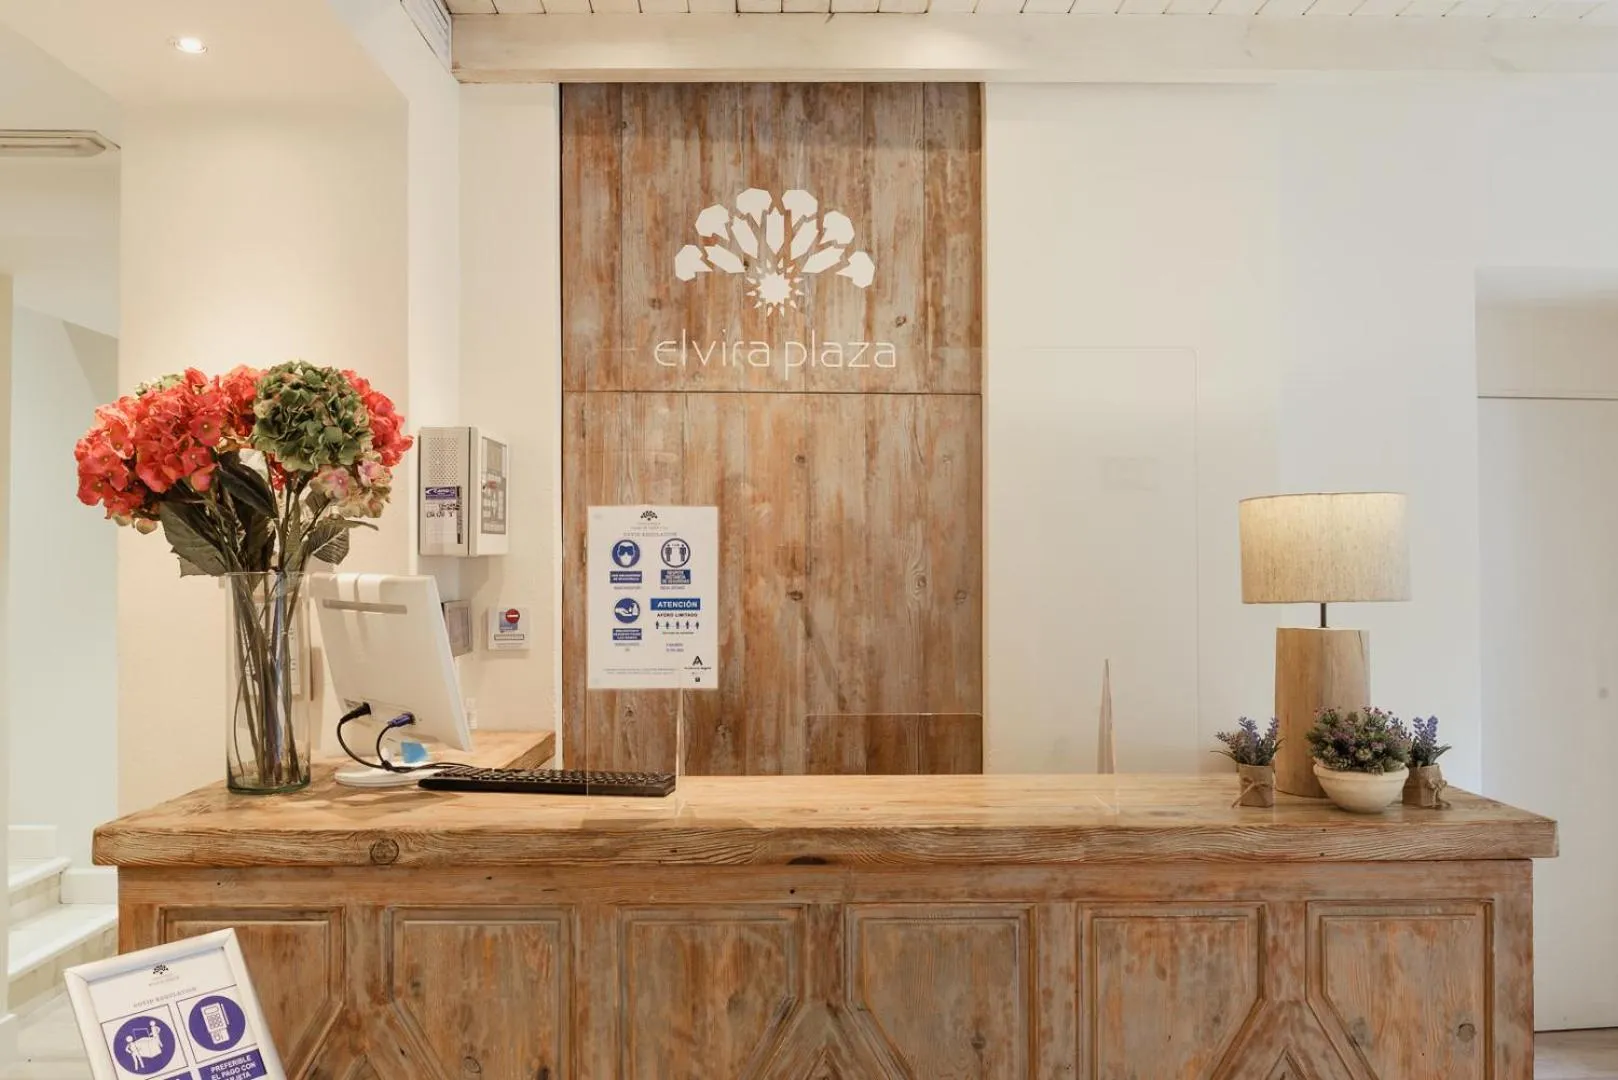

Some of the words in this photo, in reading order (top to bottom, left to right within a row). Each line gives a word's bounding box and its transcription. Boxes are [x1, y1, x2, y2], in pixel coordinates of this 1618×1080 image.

[654, 328, 770, 367] elvira
[784, 328, 896, 381] plaza
[657, 600, 698, 608] ATENCIÓN
[210, 1055, 252, 1073] PREFERIBLE
[221, 1067, 240, 1078] PAGO
[241, 1062, 256, 1071] CON
